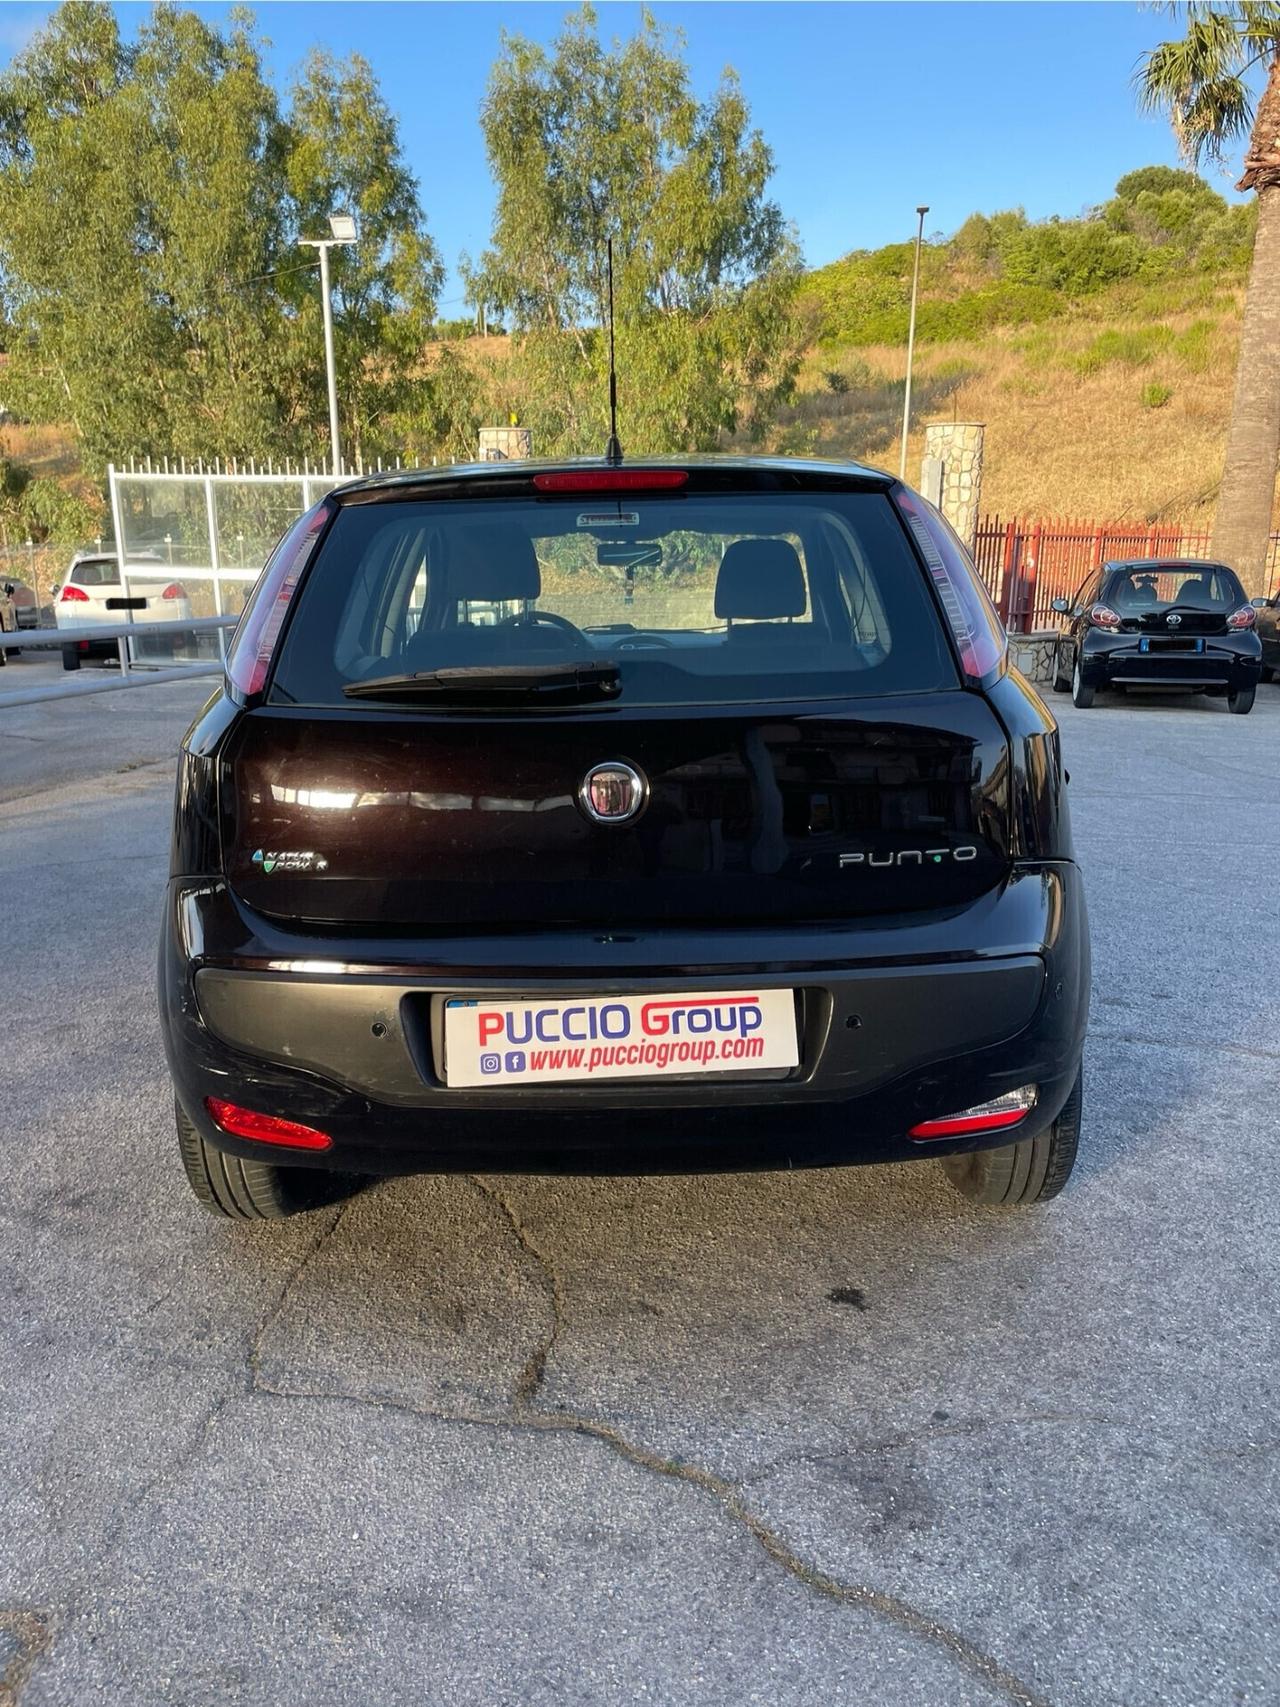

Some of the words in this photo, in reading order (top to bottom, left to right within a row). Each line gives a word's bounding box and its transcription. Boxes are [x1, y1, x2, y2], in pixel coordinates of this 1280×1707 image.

[839, 846, 977, 868] PUNTO
[478, 1003, 631, 1047] PUCCIO
[640, 996, 763, 1038] Group
[529, 1036, 765, 1072] www.pucciogroup.com
